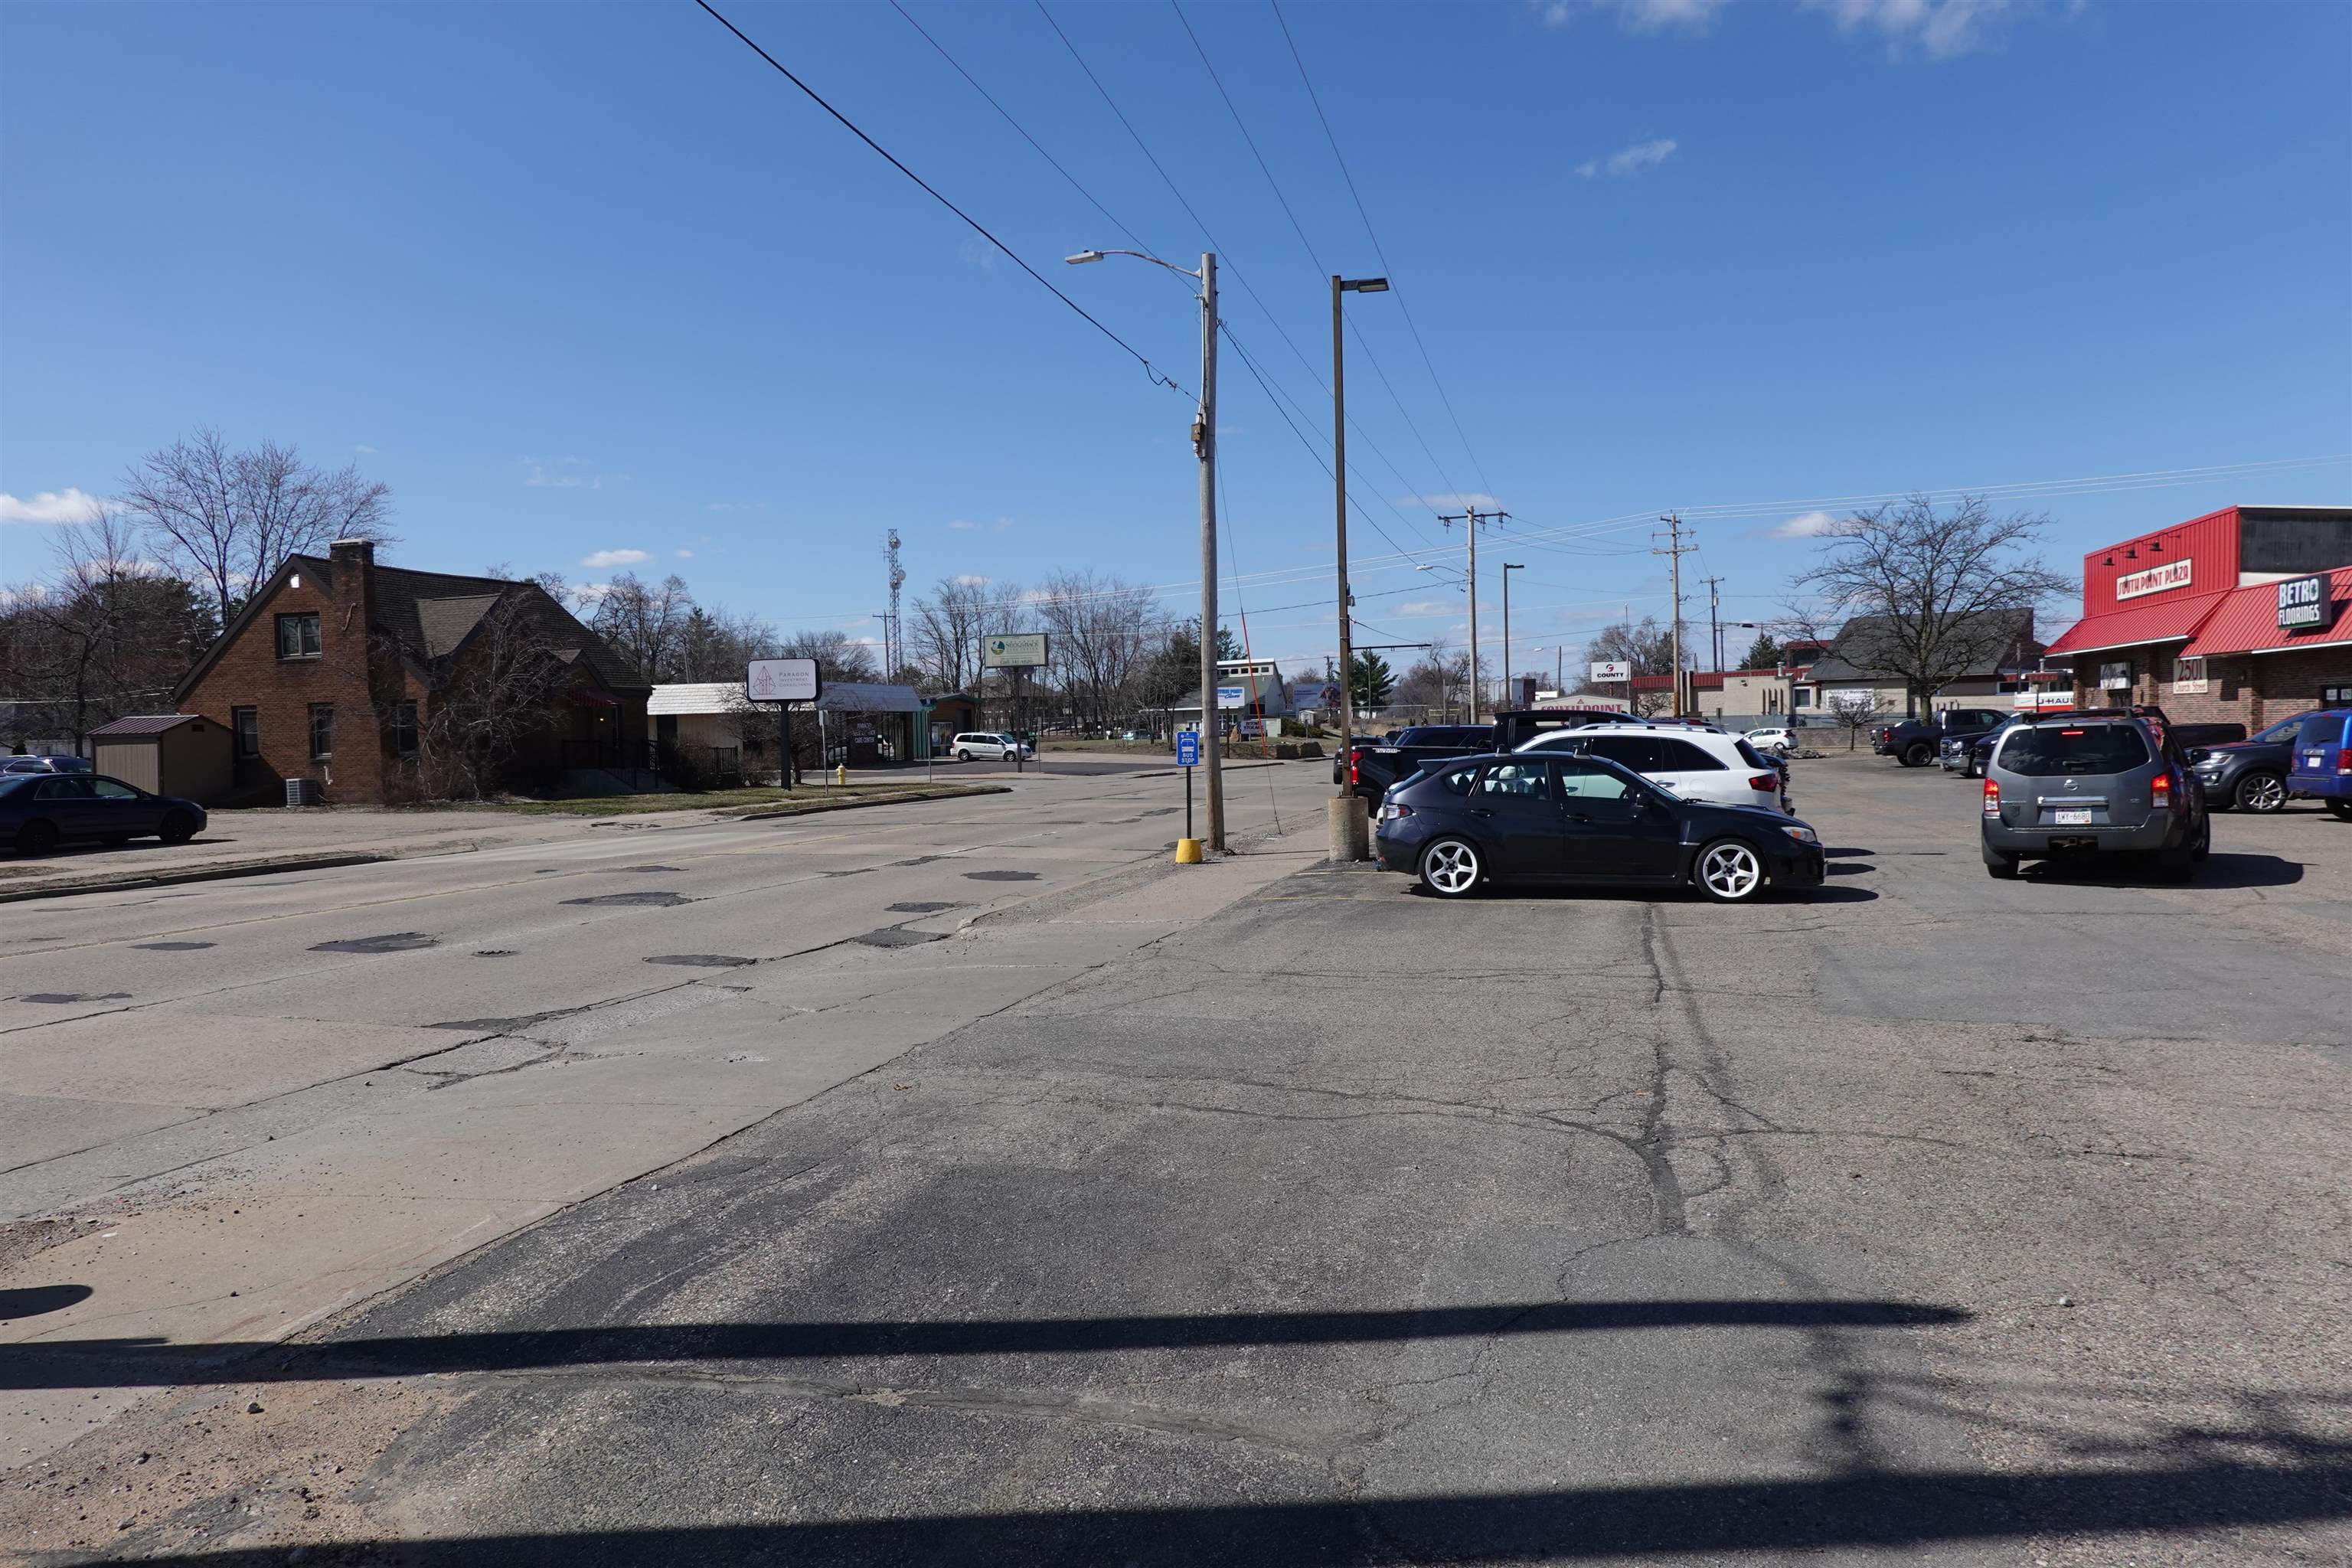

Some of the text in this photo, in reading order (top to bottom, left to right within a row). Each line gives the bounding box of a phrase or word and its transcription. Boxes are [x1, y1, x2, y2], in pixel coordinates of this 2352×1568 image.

[2118, 565, 2188, 595] SOUTH POINT PLAZA
[2278, 578, 2319, 608] BETRO
[2278, 604, 2320, 626] FLOORINGS
[2177, 659, 2202, 681] 2501
